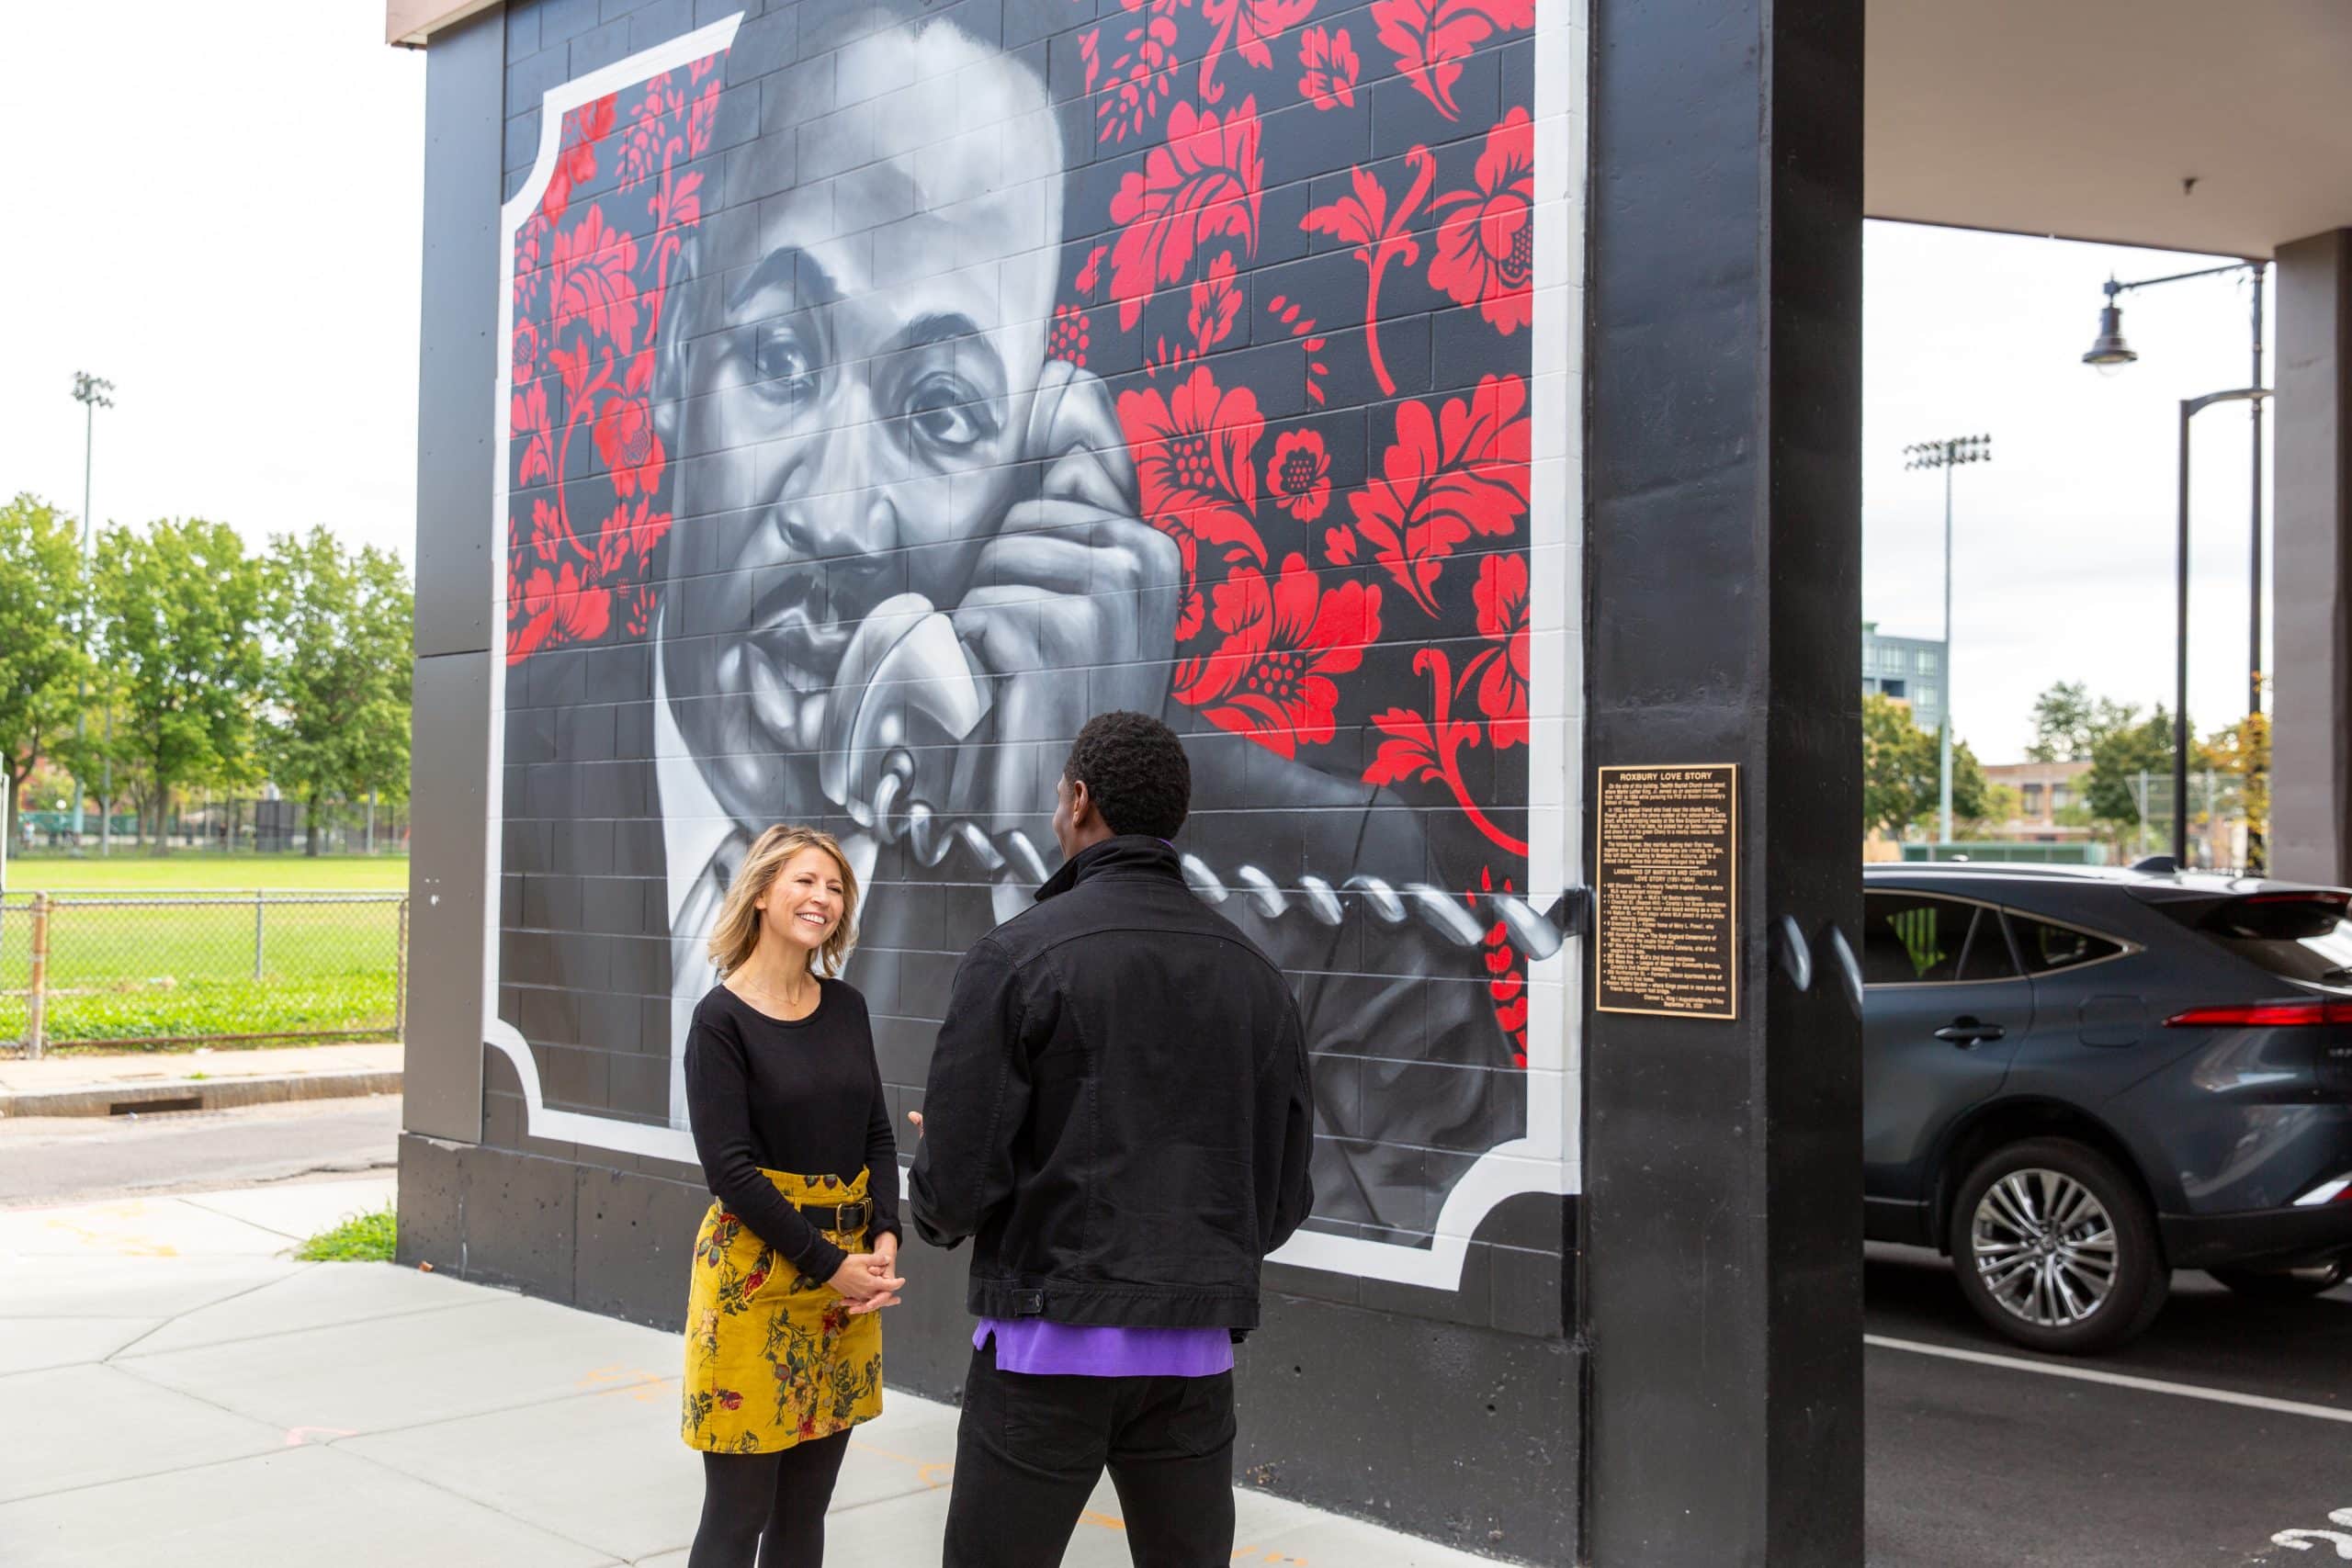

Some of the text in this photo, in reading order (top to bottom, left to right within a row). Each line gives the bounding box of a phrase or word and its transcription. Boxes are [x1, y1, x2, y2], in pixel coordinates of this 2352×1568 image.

[1620, 772, 1713, 781] ROXBURY LOVE STORY
